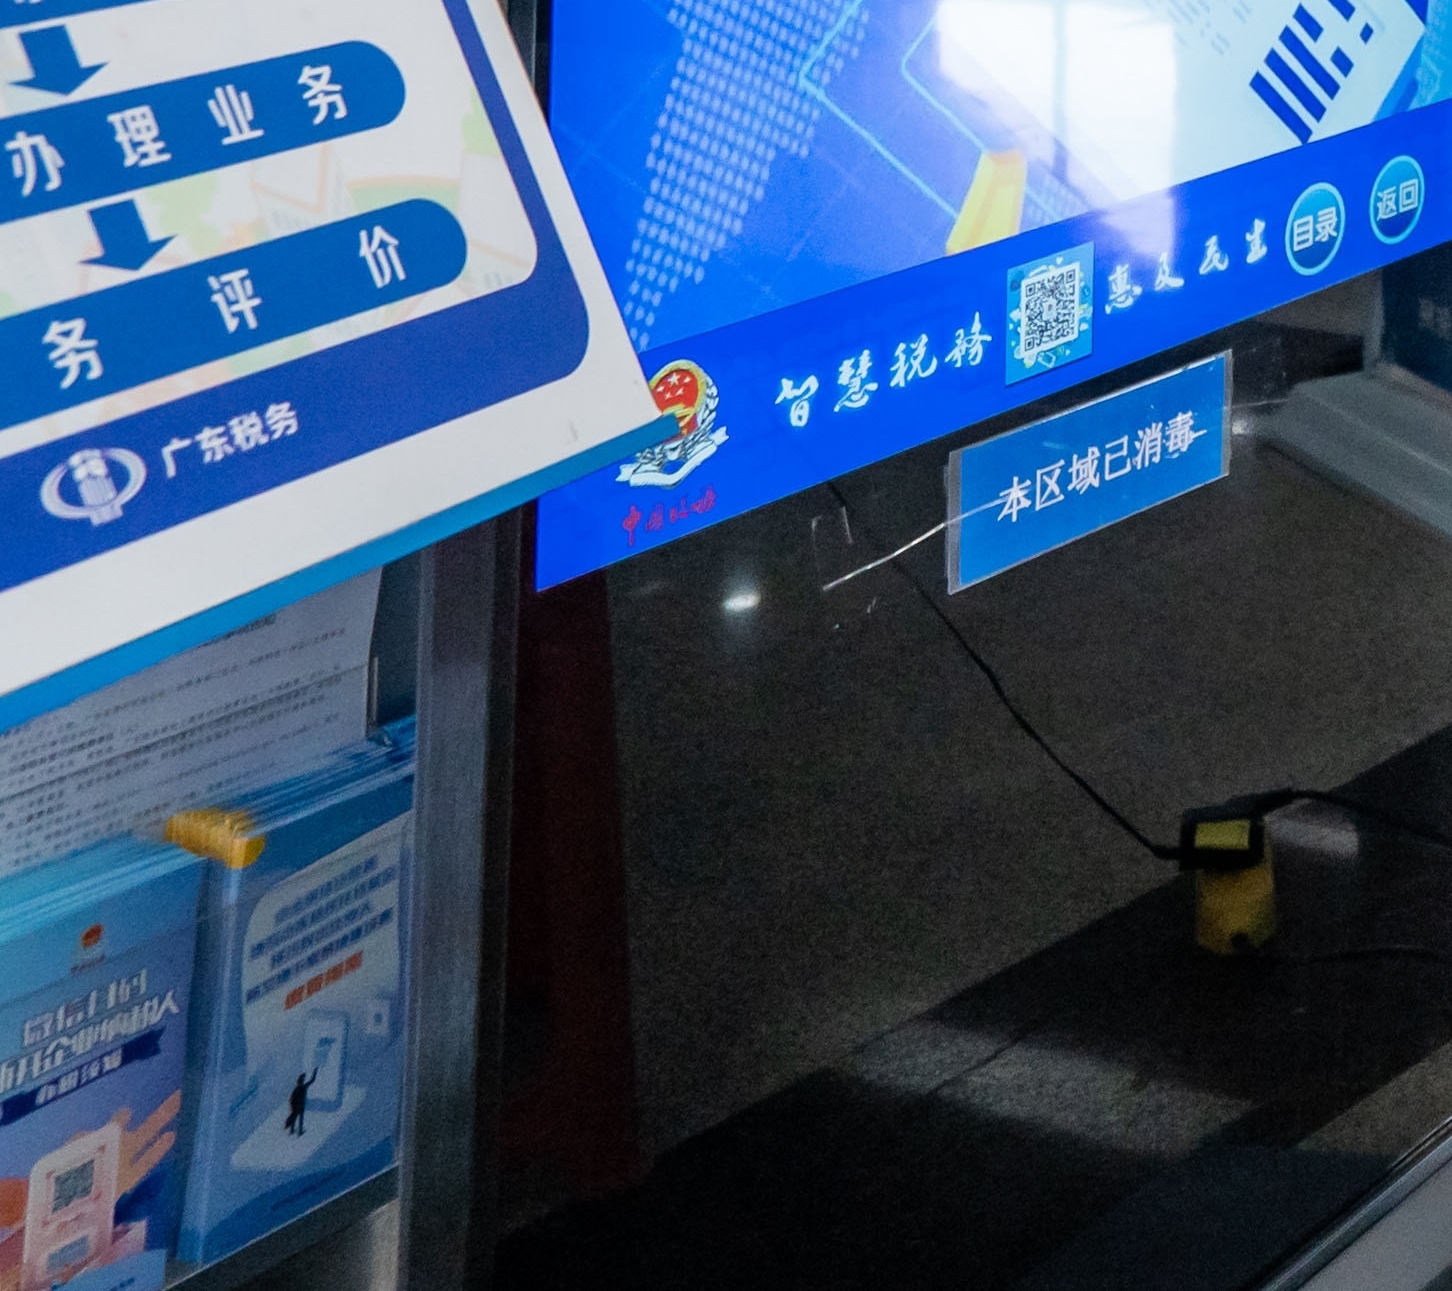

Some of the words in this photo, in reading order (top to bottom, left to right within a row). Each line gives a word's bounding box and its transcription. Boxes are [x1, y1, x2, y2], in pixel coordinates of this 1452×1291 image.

[9, 63, 349, 197] 办理业务
[1292, 206, 1338, 252] 目录
[1376, 178, 1419, 221] 返回
[159, 400, 299, 479] 广东税务
[997, 410, 1196, 523] 本区域已消毒
